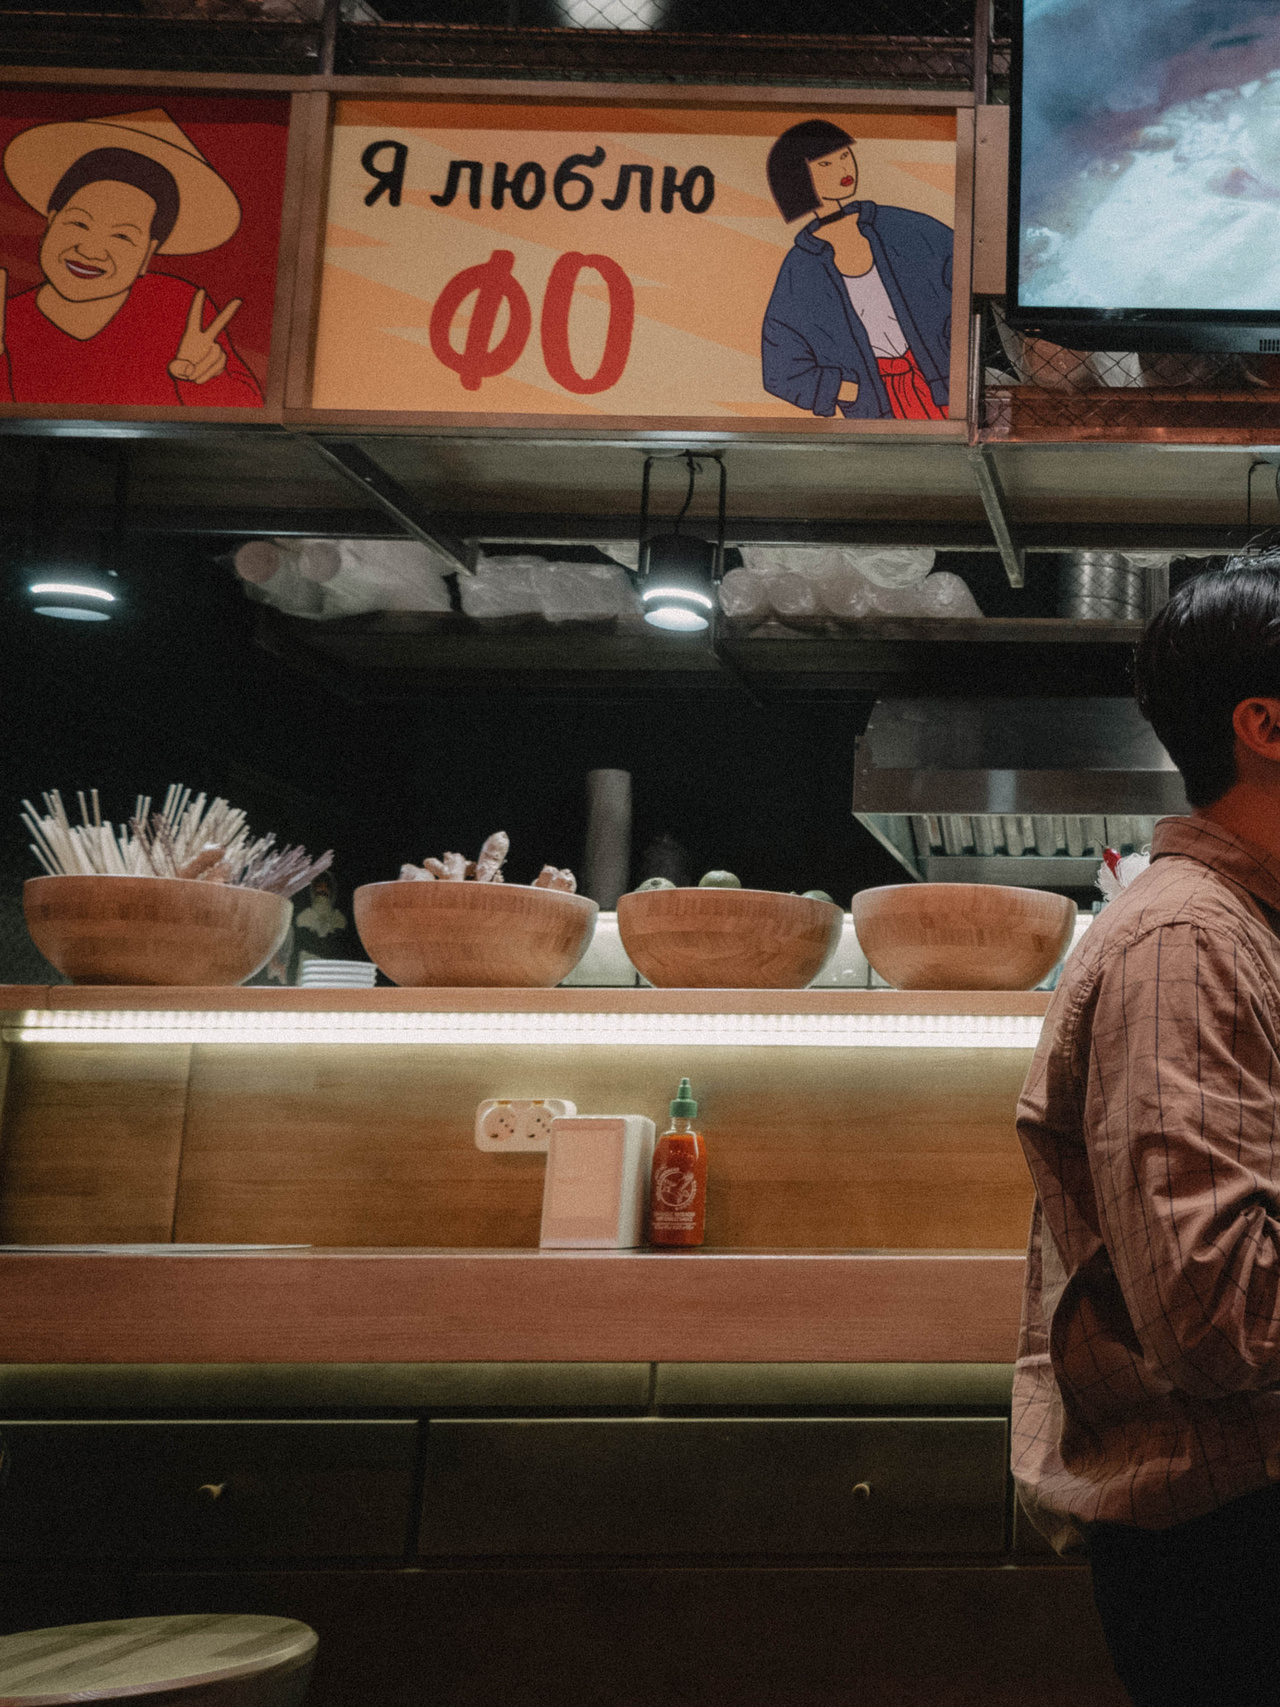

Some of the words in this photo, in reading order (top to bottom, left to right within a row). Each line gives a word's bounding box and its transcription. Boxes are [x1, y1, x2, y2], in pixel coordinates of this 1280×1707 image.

[360, 140, 409, 208] Я
[430, 146, 716, 214] люблю
[428, 249, 636, 396] ФО
